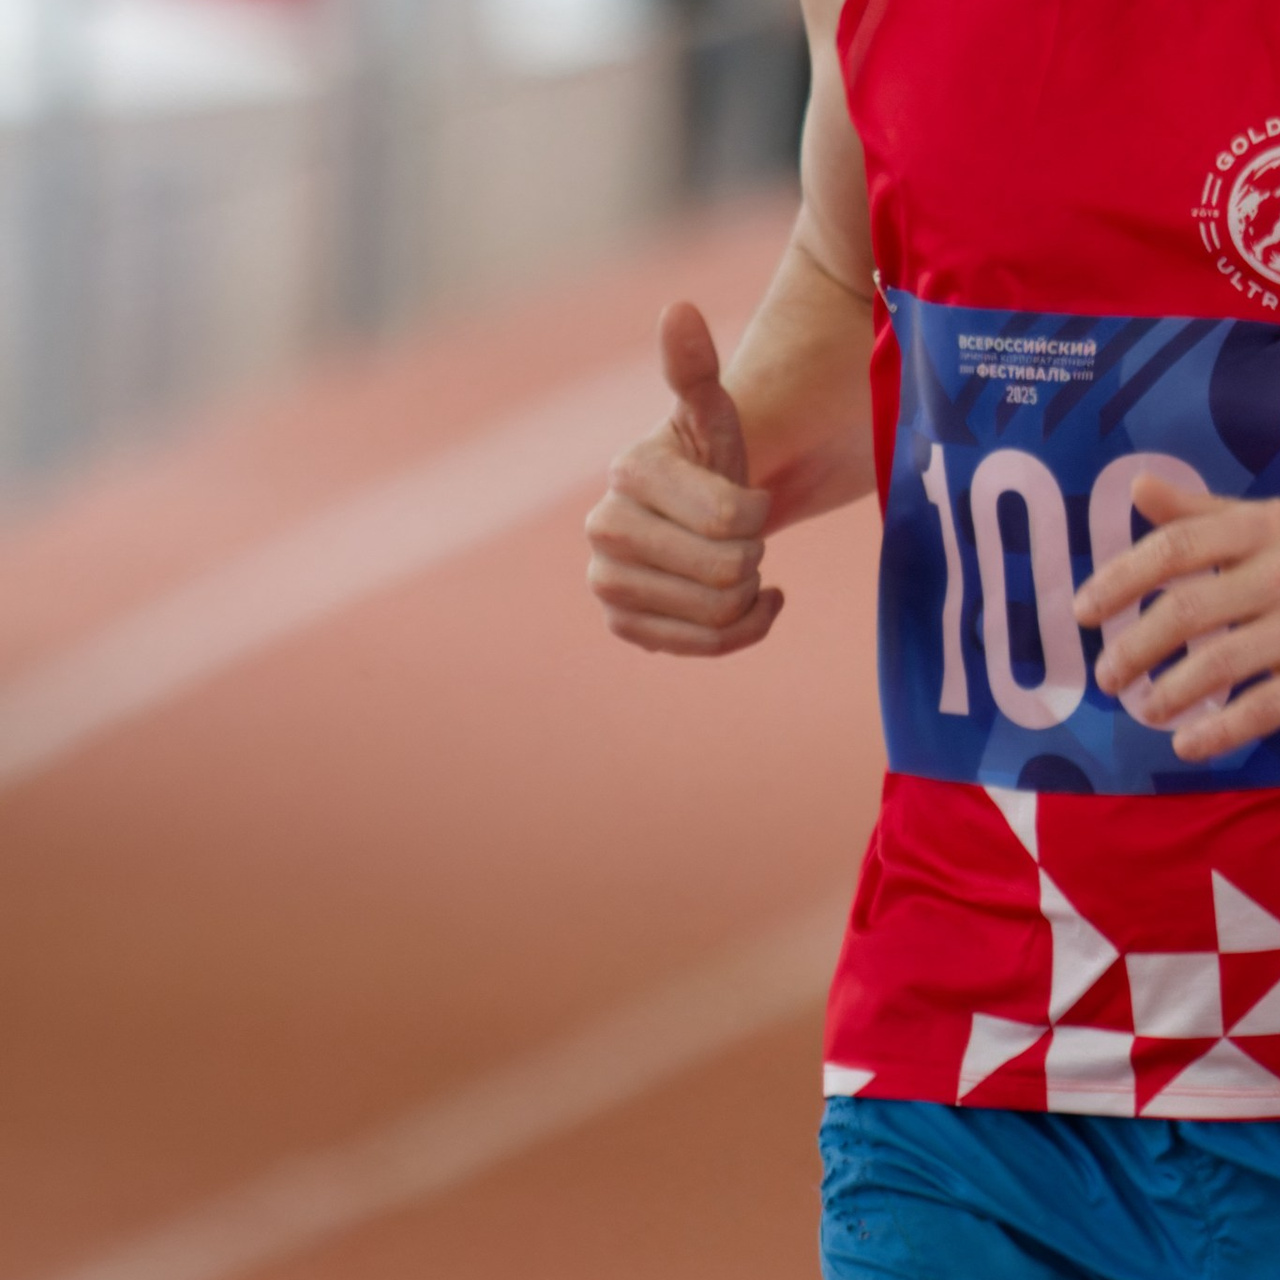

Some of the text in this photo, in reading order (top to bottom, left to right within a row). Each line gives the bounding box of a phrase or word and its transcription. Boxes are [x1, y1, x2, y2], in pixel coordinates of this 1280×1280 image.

[958, 334, 1097, 356] ВСЕРОССИЙСКИЙ
[976, 363, 1071, 382] ФЕСТИВАЛЬ
[1006, 385, 1038, 405] 2025
